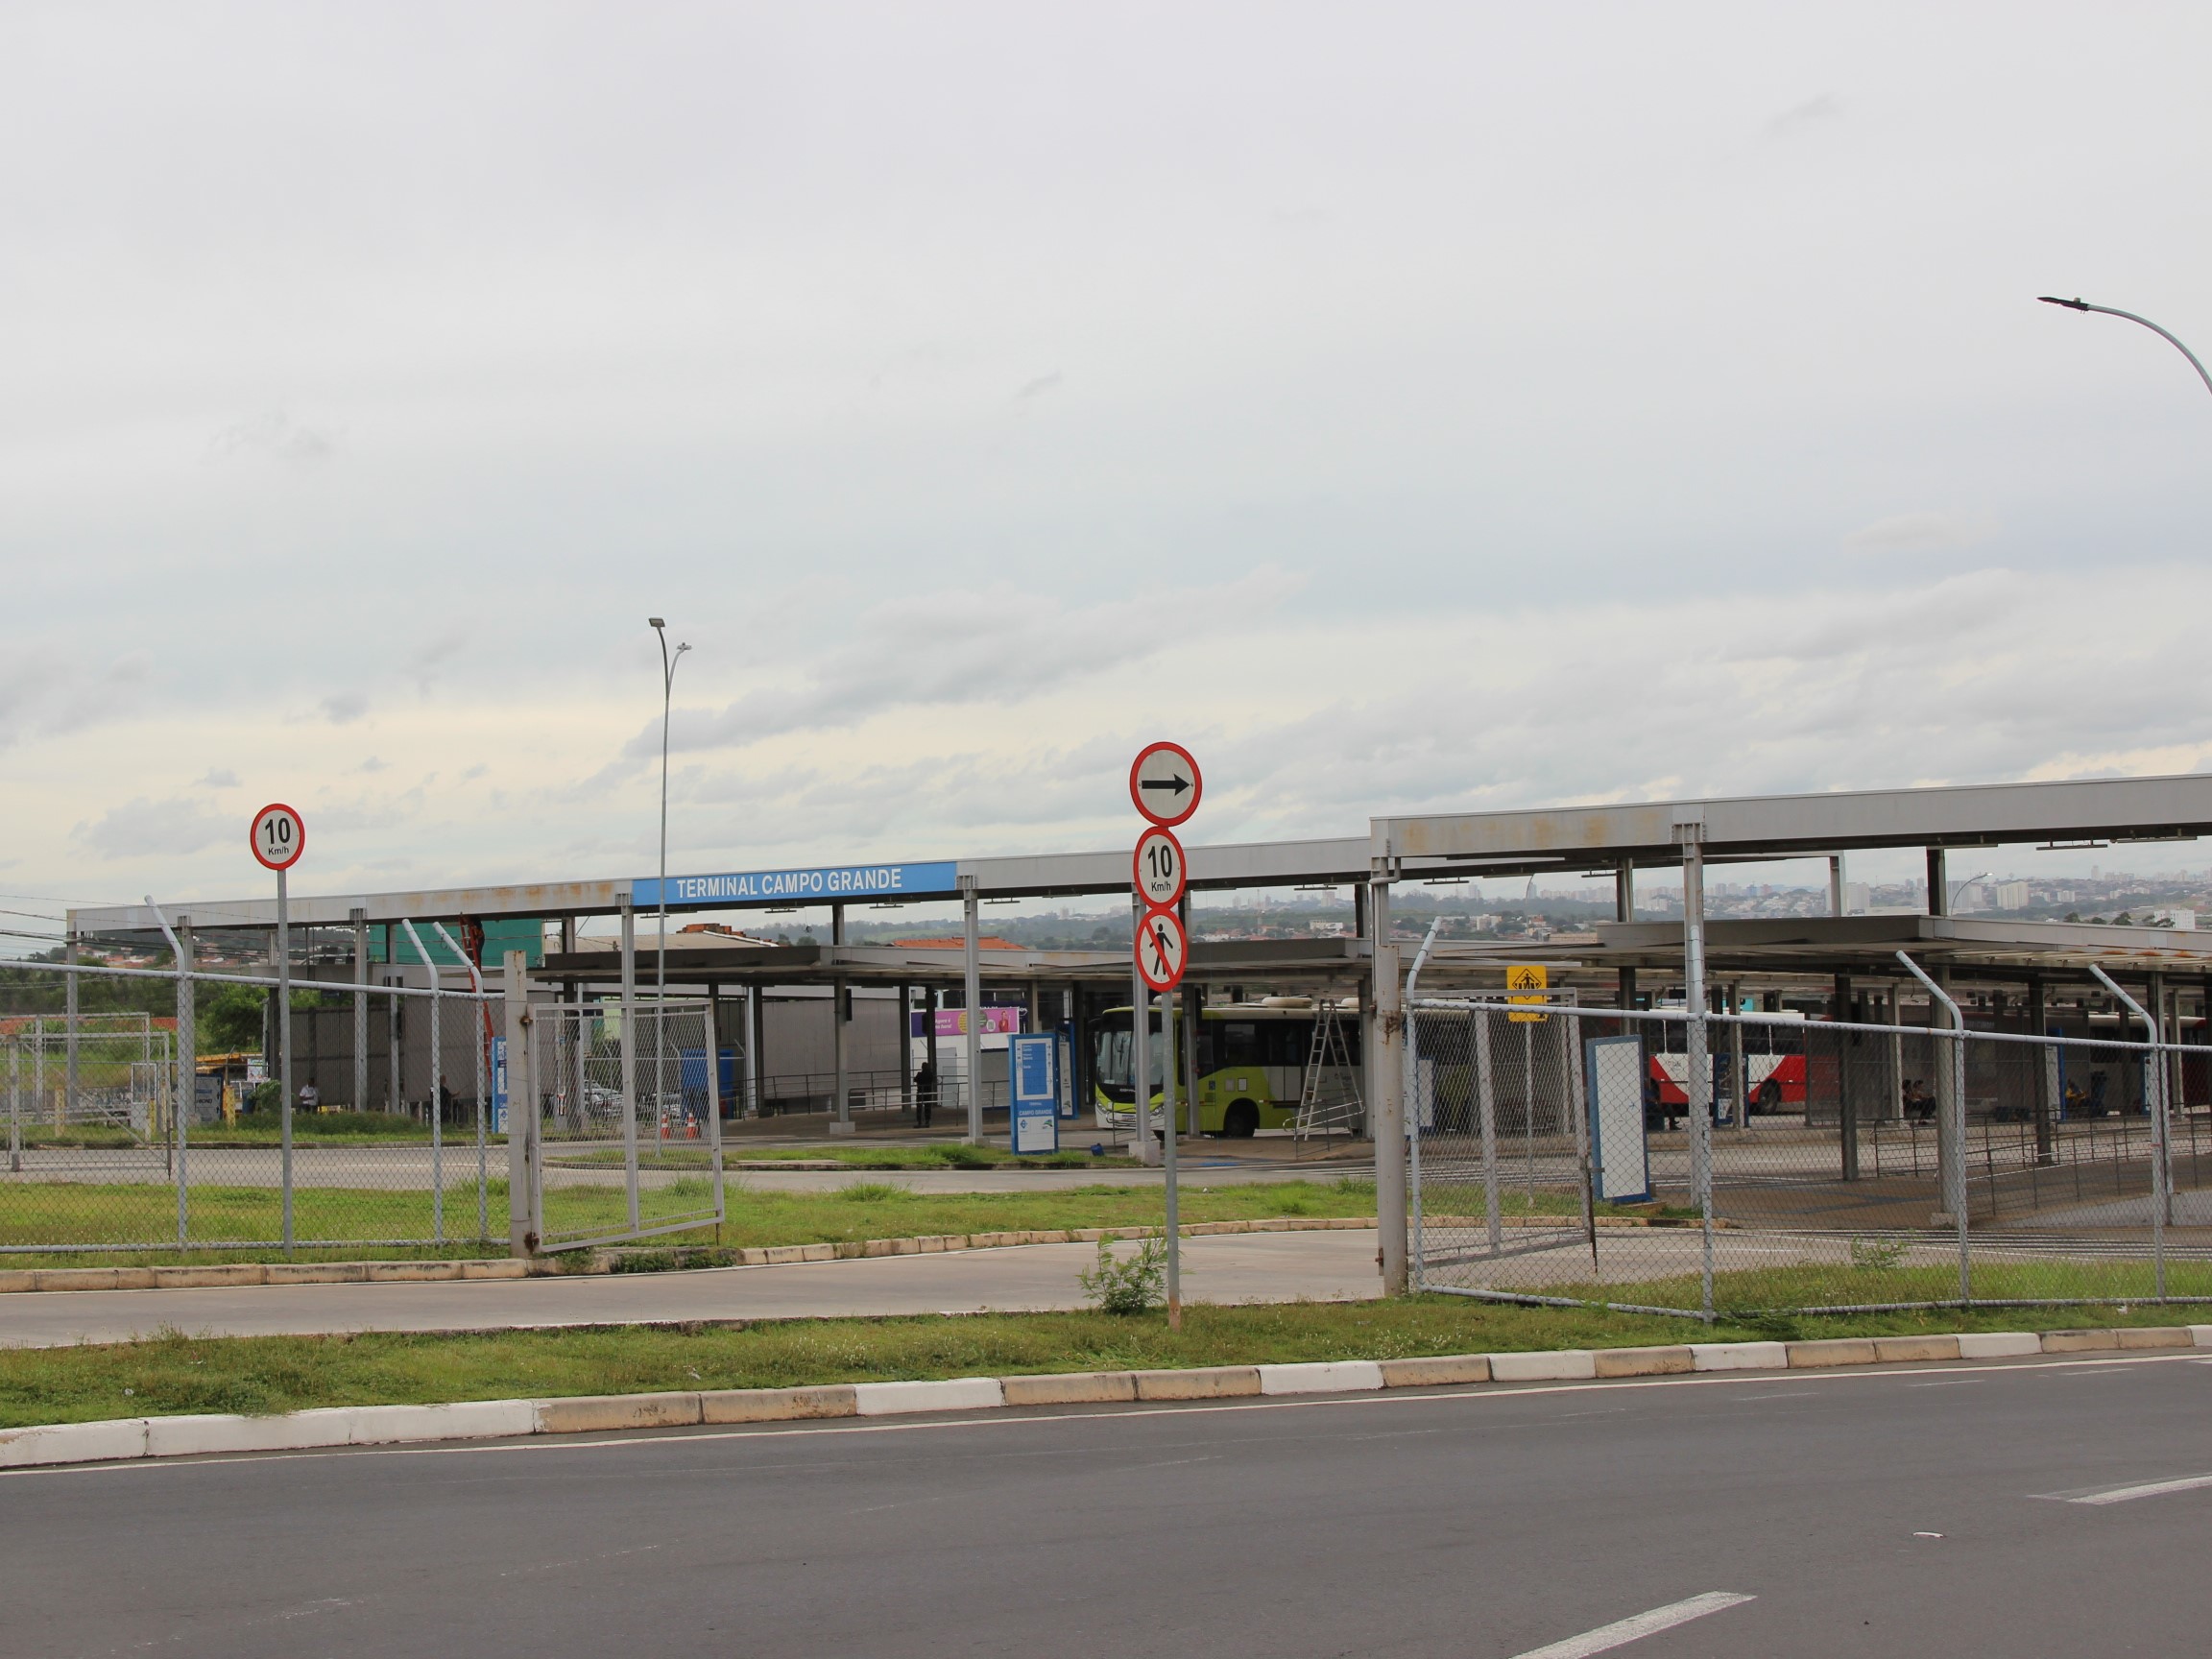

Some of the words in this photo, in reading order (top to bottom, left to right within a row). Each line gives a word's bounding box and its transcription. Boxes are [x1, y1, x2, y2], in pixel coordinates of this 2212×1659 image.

[265, 818, 291, 845] 10
[268, 846, 290, 855] Km/h
[1147, 845, 1173, 878] 10
[677, 876, 758, 898] TERMINAL
[761, 872, 823, 894] CAMPO
[828, 868, 902, 891] GRANDE
[1151, 881, 1171, 892] Km/h
